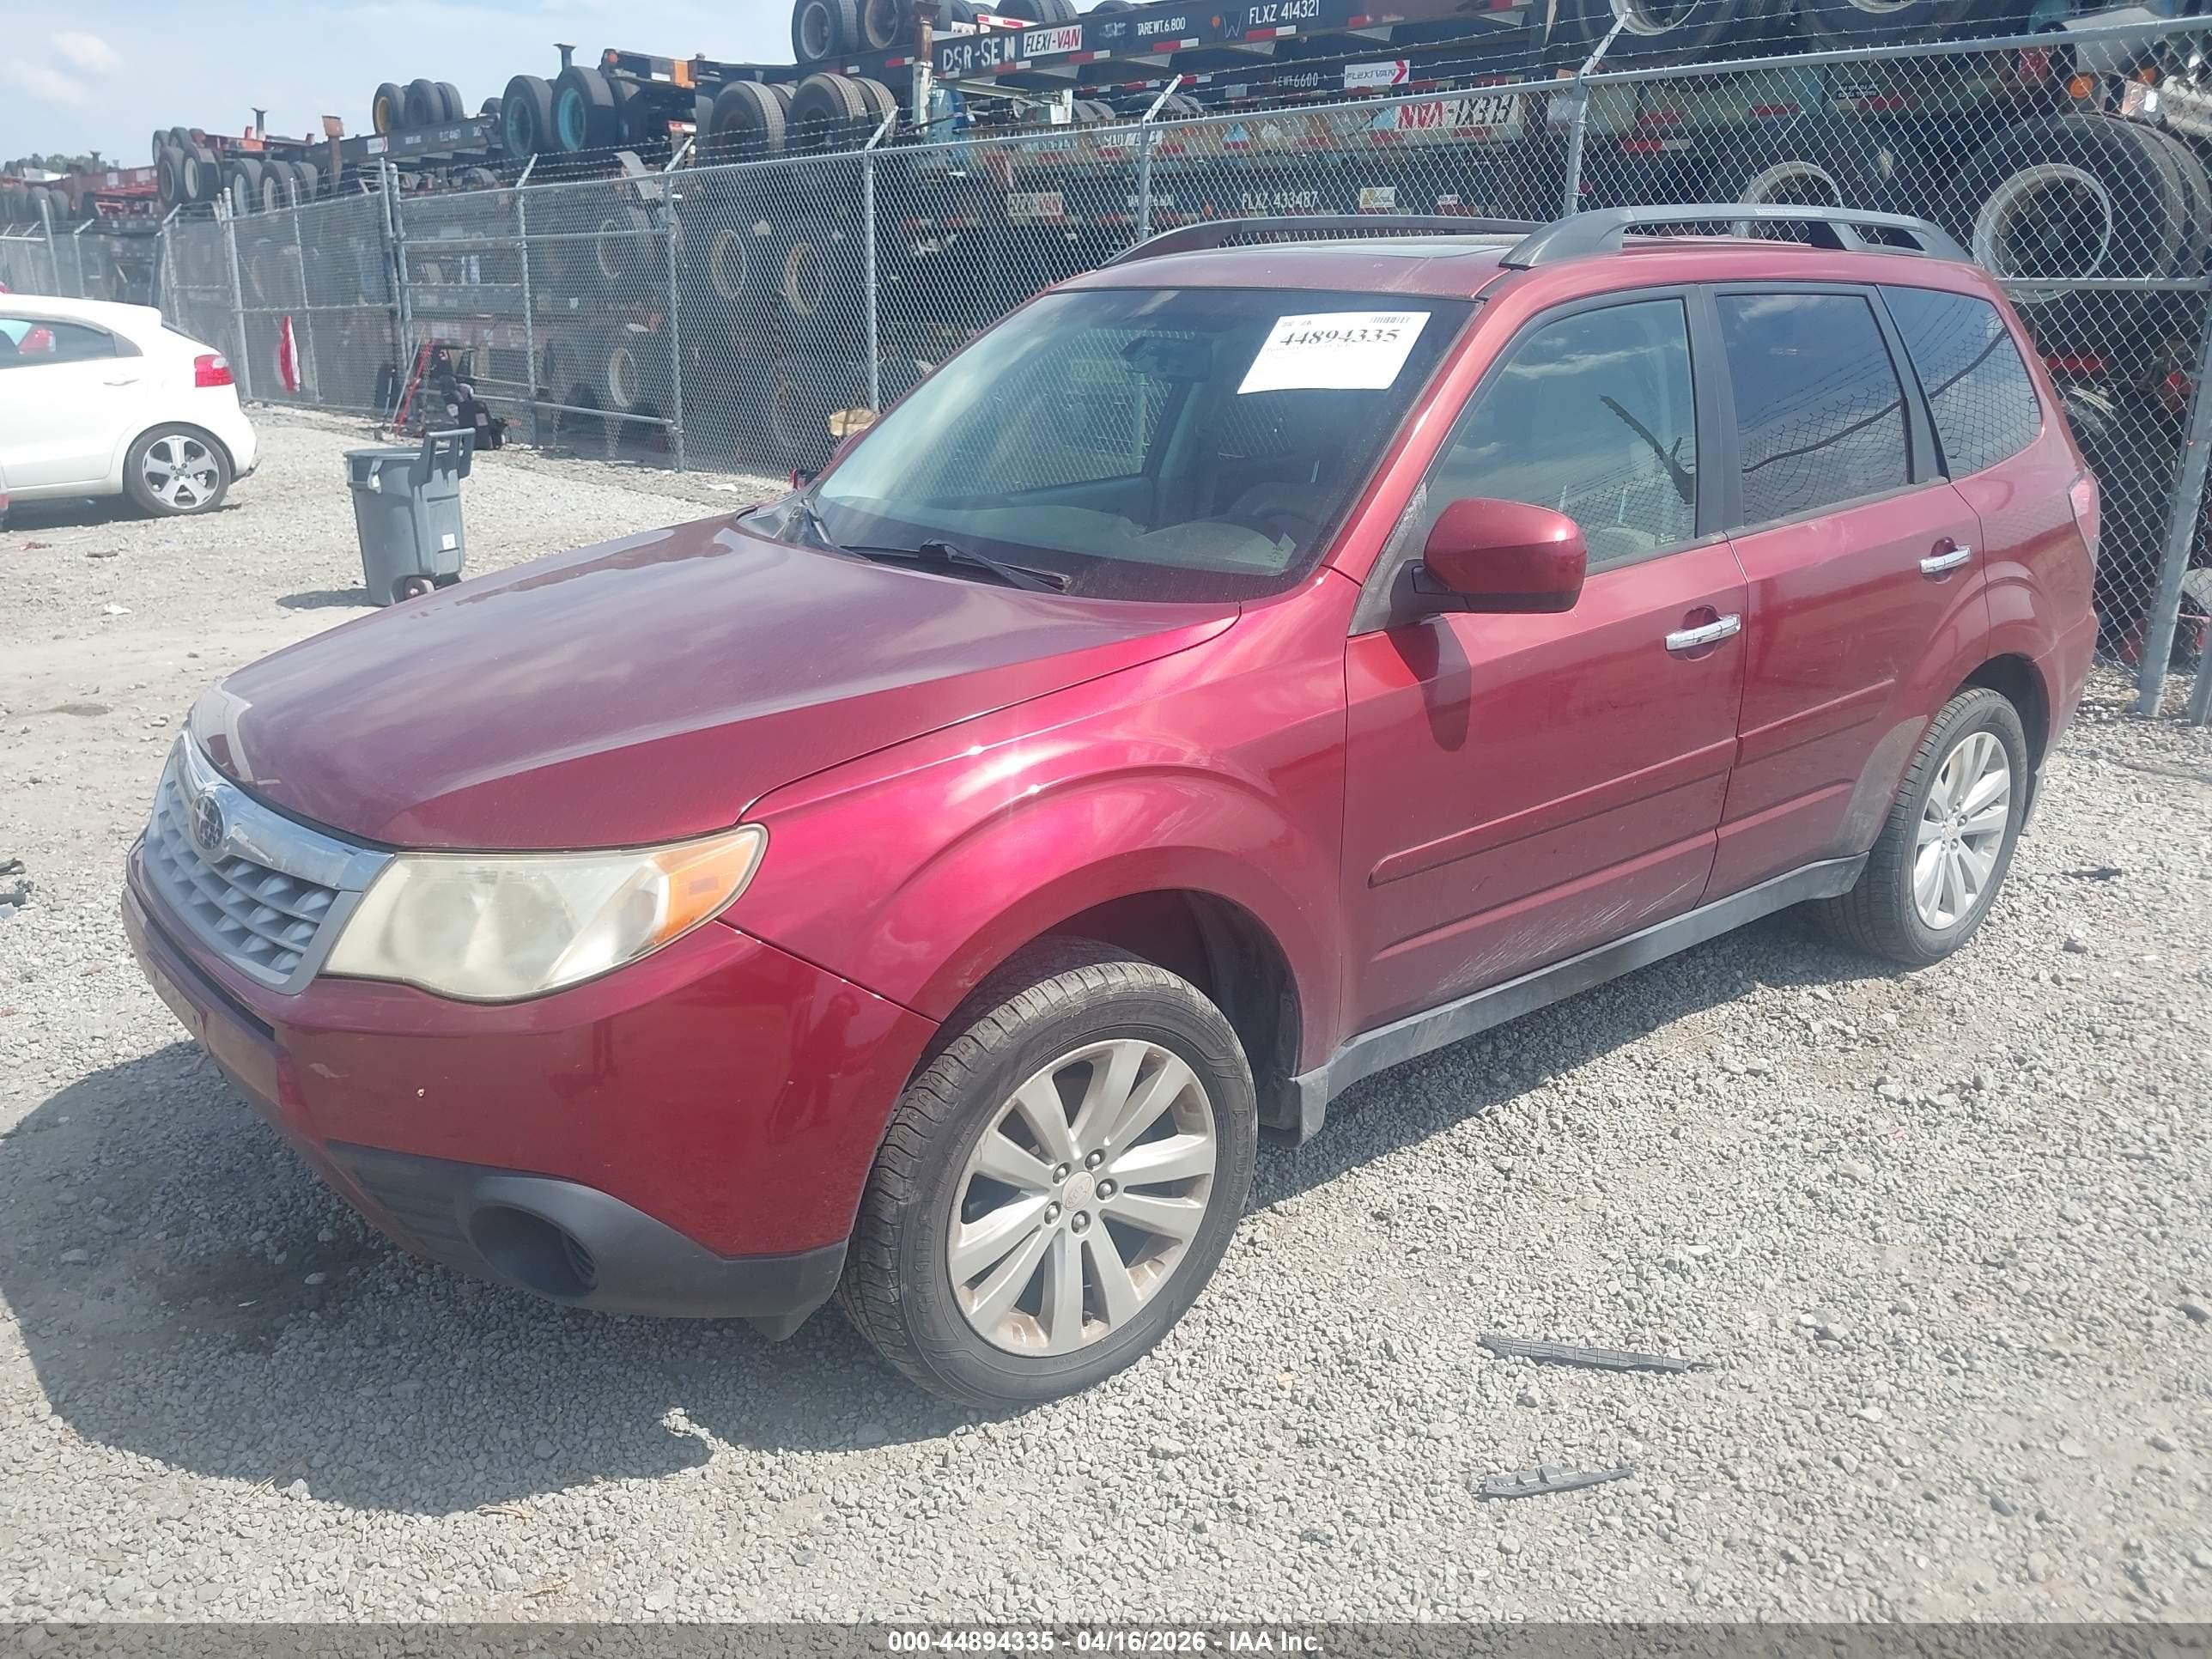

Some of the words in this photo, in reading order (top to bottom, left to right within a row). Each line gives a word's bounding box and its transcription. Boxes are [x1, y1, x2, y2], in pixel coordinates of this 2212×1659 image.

[1248, 4, 1277, 26] FLXZ
[1280, 0, 1320, 19] 414321
[1024, 27, 1081, 54] FLEXI-VAN
[1242, 192, 1268, 210] FLXZ
[1273, 190, 1319, 209] 433487
[1279, 329, 1401, 346] 44894335
